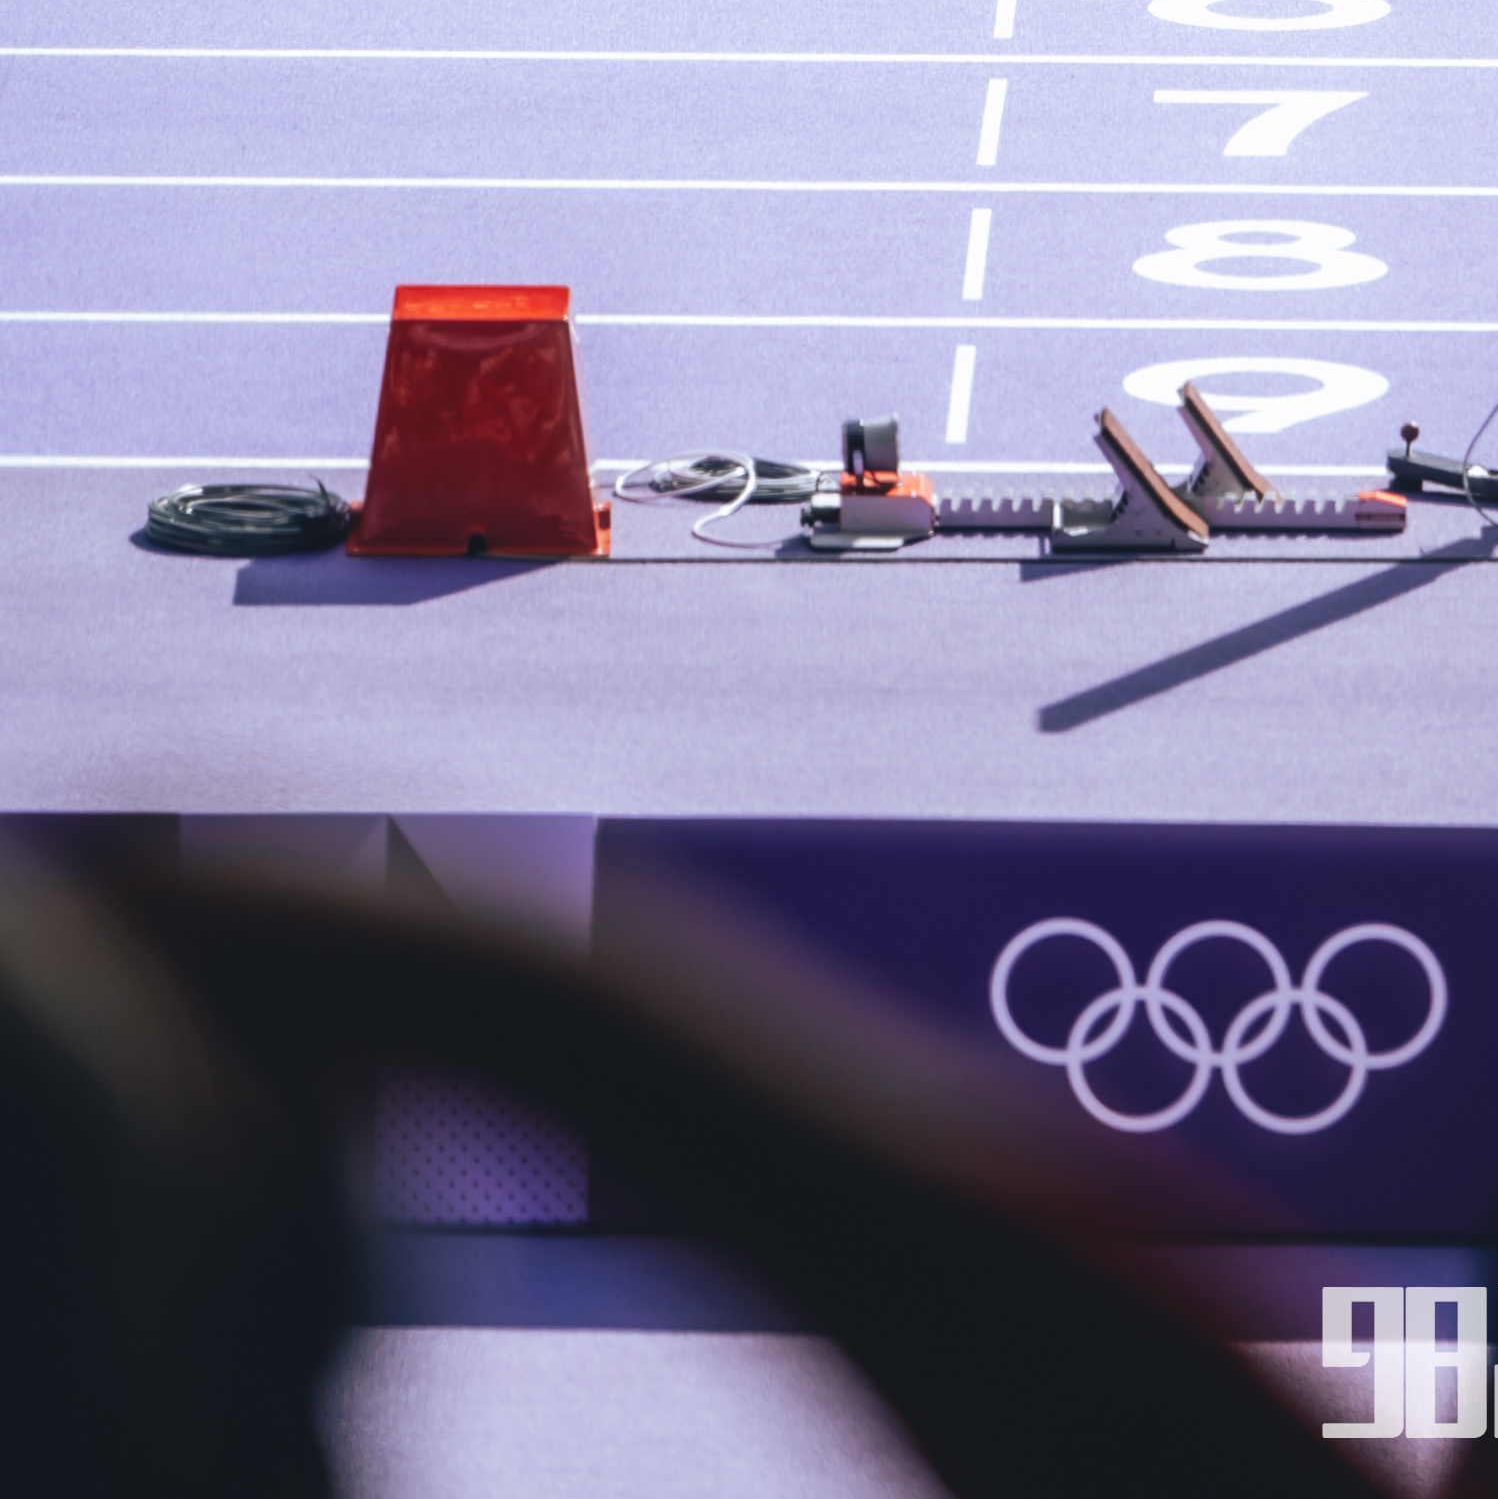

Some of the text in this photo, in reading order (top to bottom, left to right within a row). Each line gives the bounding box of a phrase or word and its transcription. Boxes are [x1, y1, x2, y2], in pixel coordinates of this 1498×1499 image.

[1153, 89, 1370, 157] 7
[1132, 219, 1389, 291] 8
[1122, 356, 1390, 434] 9
